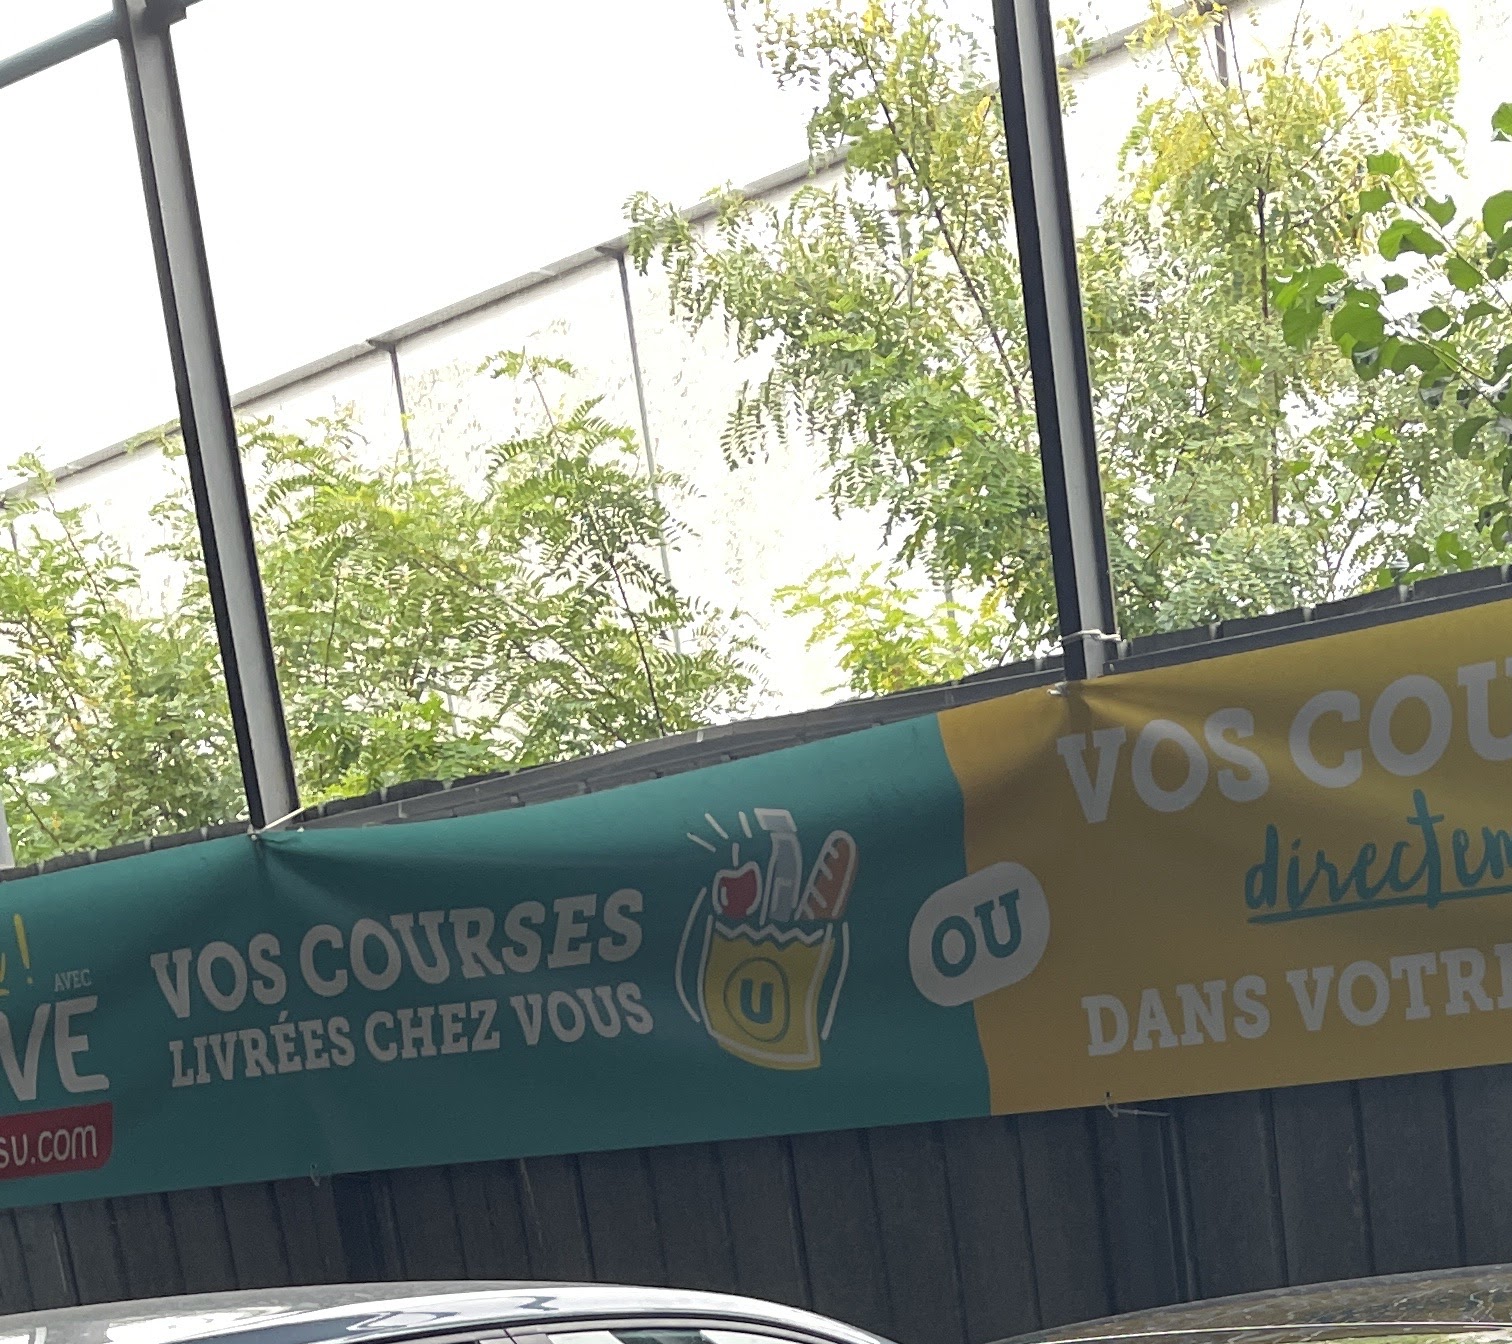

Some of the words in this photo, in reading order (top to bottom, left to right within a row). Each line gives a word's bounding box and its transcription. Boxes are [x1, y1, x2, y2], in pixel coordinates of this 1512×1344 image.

[1057, 708, 1270, 824] VOS
[53, 968, 92, 993] AVEC
[150, 933, 287, 1018] VOS
[301, 889, 644, 998] COURSES
[931, 888, 1021, 978] OU
[169, 1010, 356, 1088] LIVRÉES
[364, 1001, 500, 1063] CHEZ
[510, 983, 655, 1046] VOUS
[1080, 974, 1270, 1057] DANS
